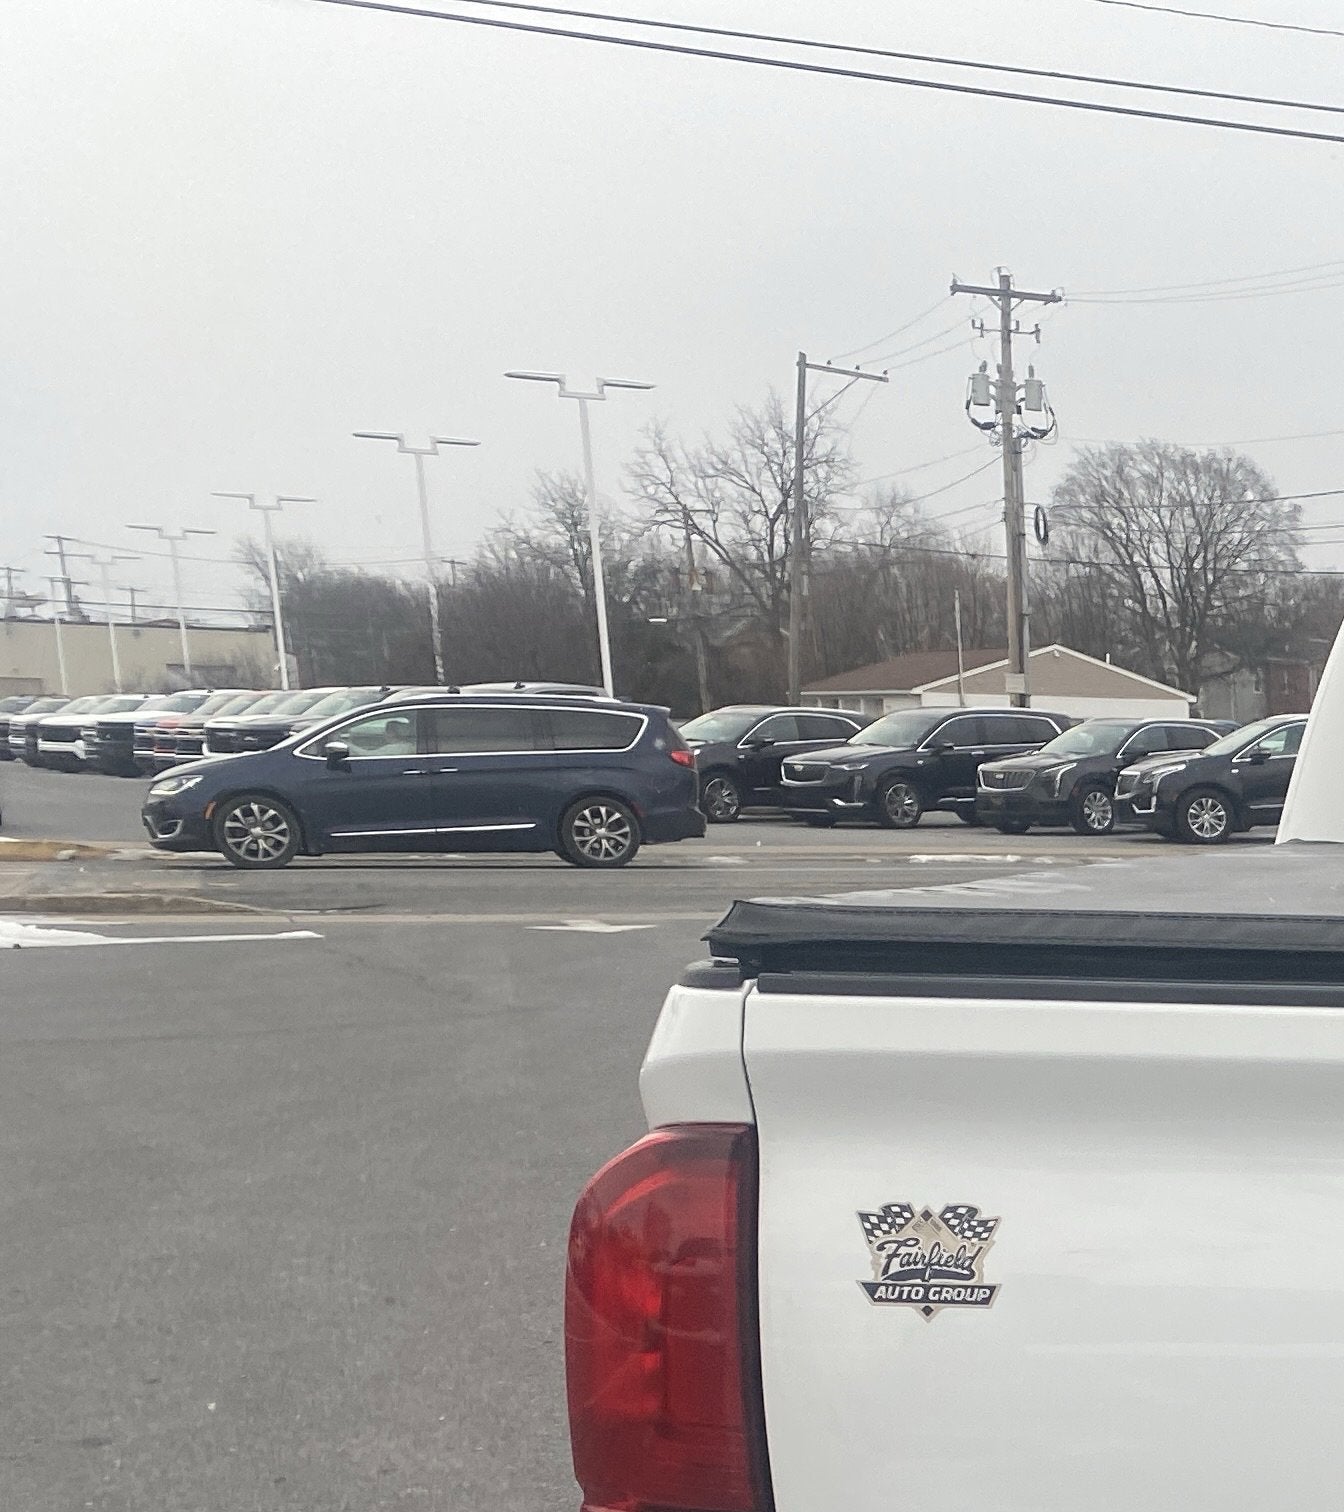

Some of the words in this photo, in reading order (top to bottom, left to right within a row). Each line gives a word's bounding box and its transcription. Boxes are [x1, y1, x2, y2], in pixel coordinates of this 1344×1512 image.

[876, 1237, 983, 1282] Fairfield
[873, 1285, 925, 1300] AUTO
[928, 1287, 991, 1302] GROUP
